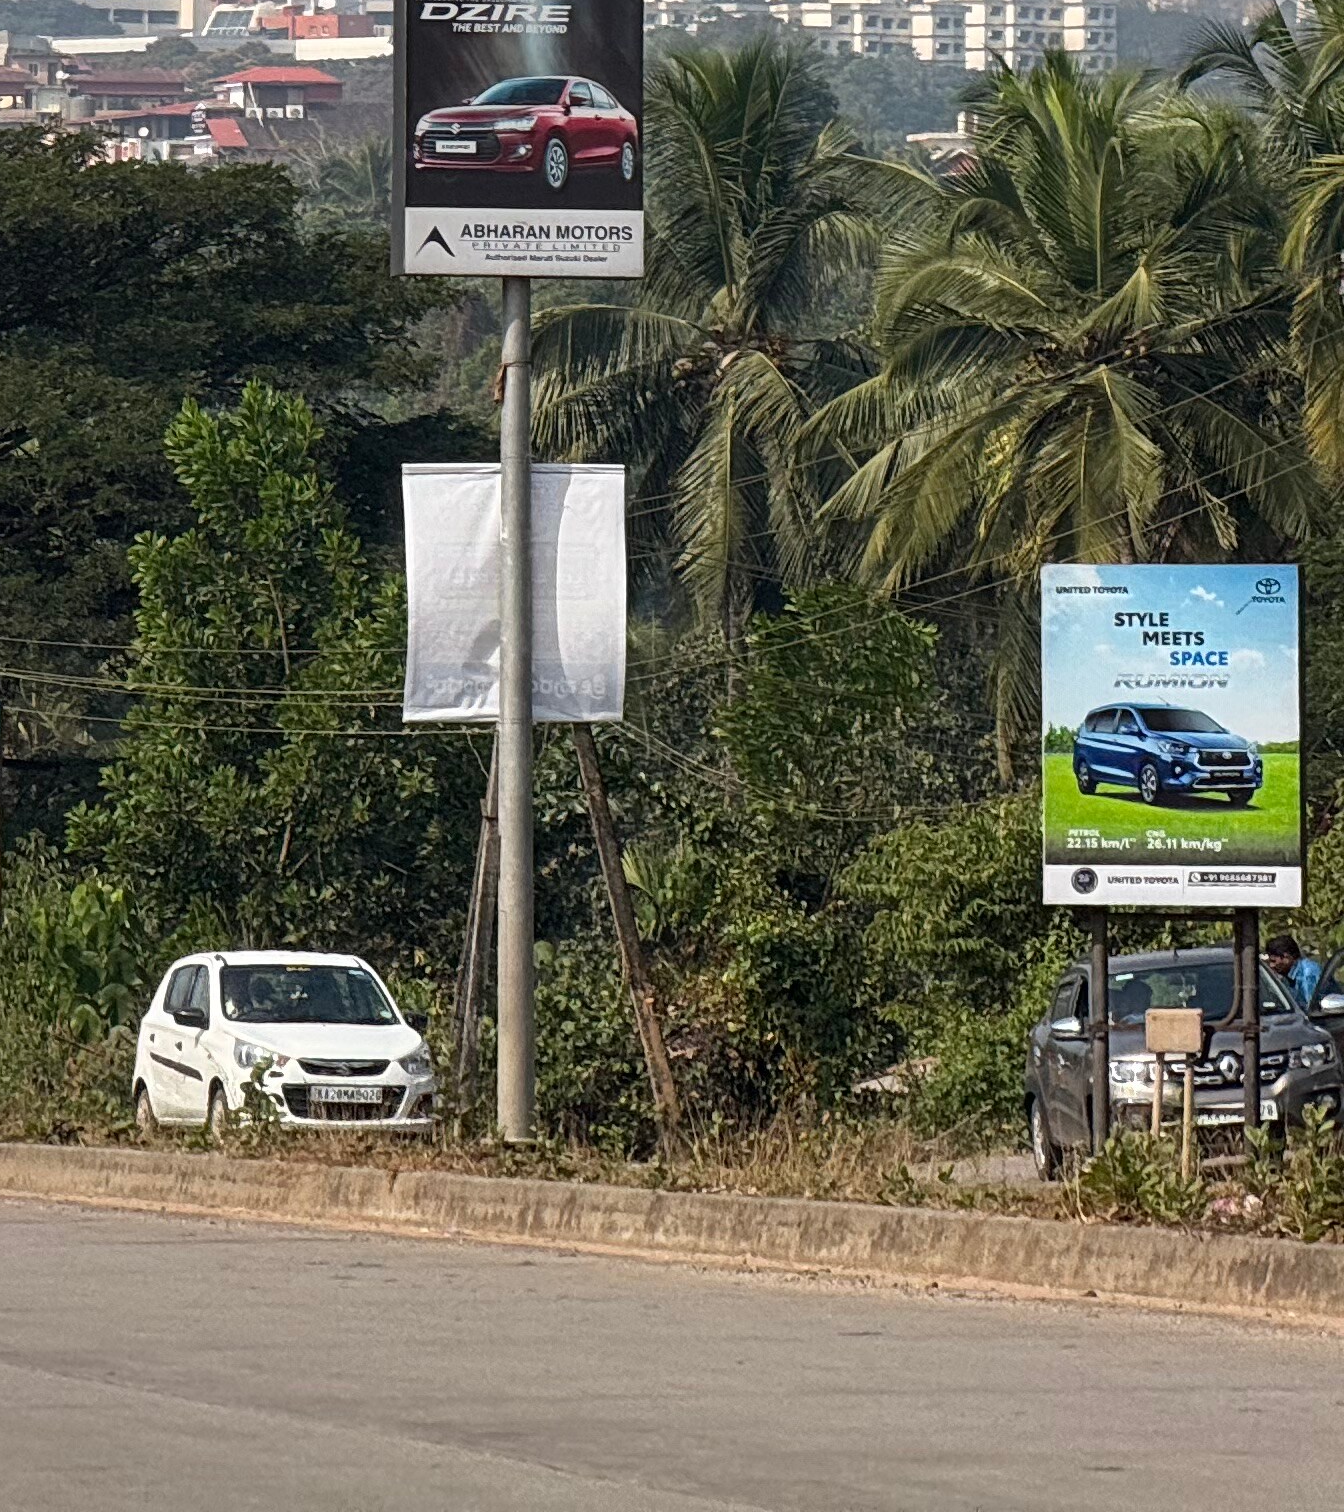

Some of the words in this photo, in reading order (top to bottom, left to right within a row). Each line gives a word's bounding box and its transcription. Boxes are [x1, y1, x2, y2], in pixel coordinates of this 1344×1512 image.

[419, 2, 572, 22] DZIRE
[452, 22, 472, 33] THE
[473, 22, 501, 33] BEST
[501, 23, 525, 34] AND
[525, 23, 568, 34] BEYOND
[460, 223, 551, 240] ABHARAN
[556, 225, 633, 241] MOTORS
[471, 242, 542, 251] PRIVATE
[552, 243, 621, 252] LIMITED
[1055, 586, 1091, 594] UNITED
[1092, 586, 1129, 594] TOYOTA
[1114, 612, 1169, 627] STYLE
[1142, 631, 1205, 646] MEETS
[1169, 651, 1229, 666] SPACE
[1114, 673, 1230, 689] RUMION
[1146, 837, 1177, 850] 26.11
[1107, 876, 1142, 884] UNITED
[1144, 876, 1180, 885] TOYOTA
